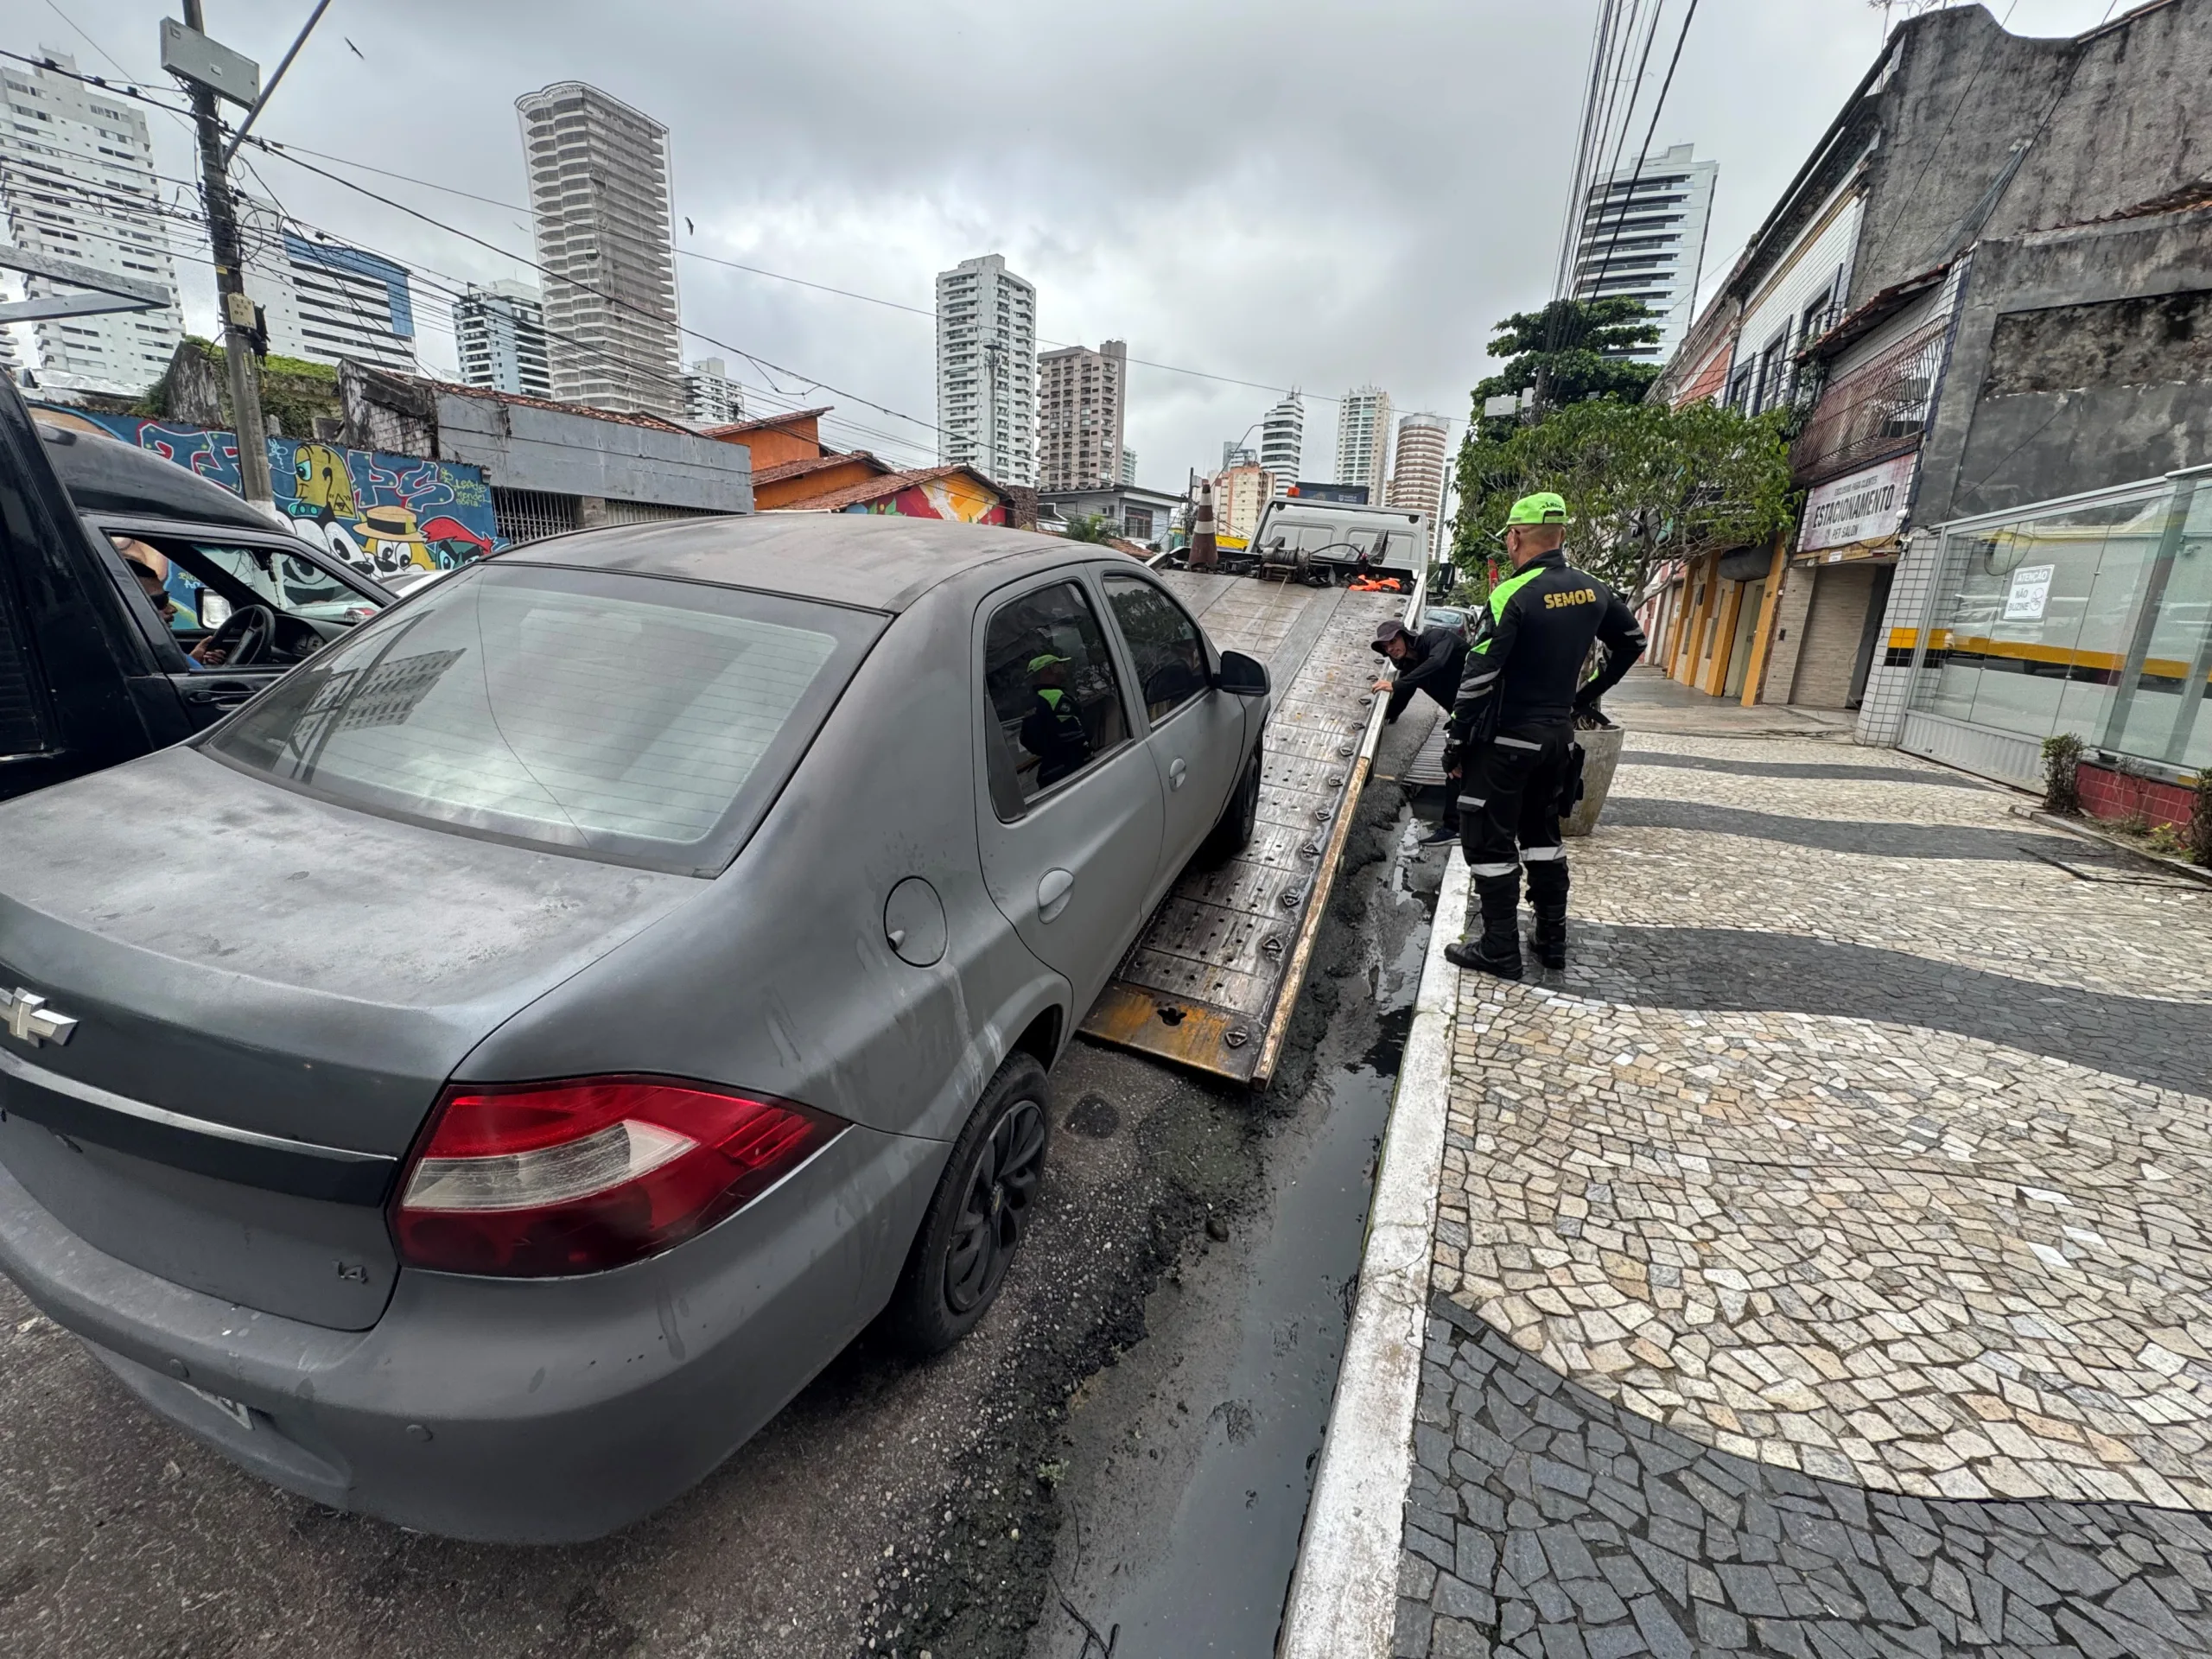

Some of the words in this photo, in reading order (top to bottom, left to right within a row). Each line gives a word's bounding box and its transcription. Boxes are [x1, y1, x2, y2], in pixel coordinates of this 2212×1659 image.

[1812, 484, 1895, 528] ESTACIONAMENTO
[1832, 528, 1841, 540] PET
[1841, 524, 1859, 537] SALON
[2016, 569, 2048, 583] ATENÇÃO
[1543, 588, 1597, 609] SEMOB
[2014, 588, 2029, 599] NÃO
